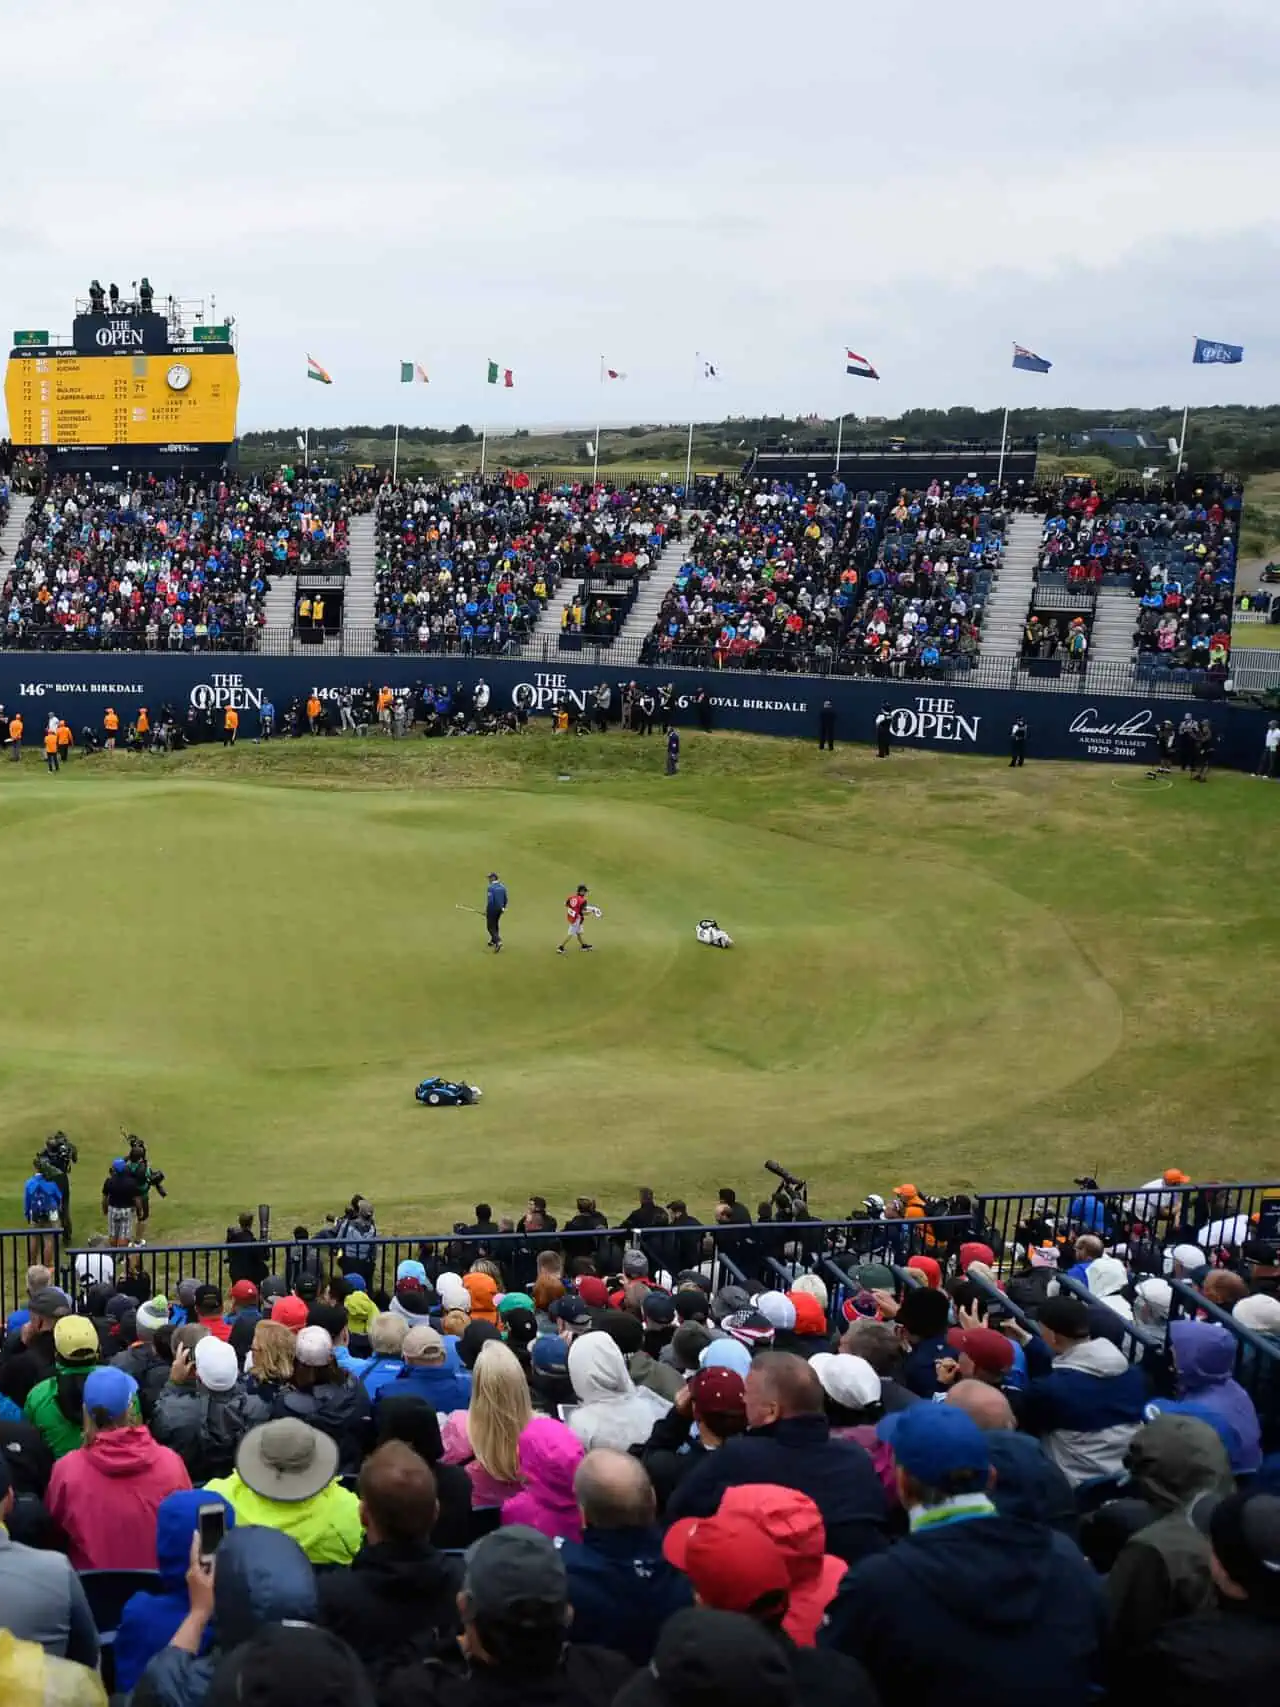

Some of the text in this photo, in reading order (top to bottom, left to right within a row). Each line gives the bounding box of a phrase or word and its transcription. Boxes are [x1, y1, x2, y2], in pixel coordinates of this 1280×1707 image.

[110, 321, 130, 331] THE
[96, 328, 144, 346] OPEN
[211, 674, 243, 688] THE
[534, 672, 568, 688] THE
[55, 684, 89, 692] ROYAL
[90, 684, 144, 693] BIRKDALE
[190, 684, 264, 710] OPEN
[743, 700, 808, 712] BIRKDALE
[915, 697, 956, 714] THE
[888, 708, 983, 742] OPEN
[1079, 737, 1147, 748] ARNOLD PALMER
[1087, 745, 1136, 757] 1929-2016
